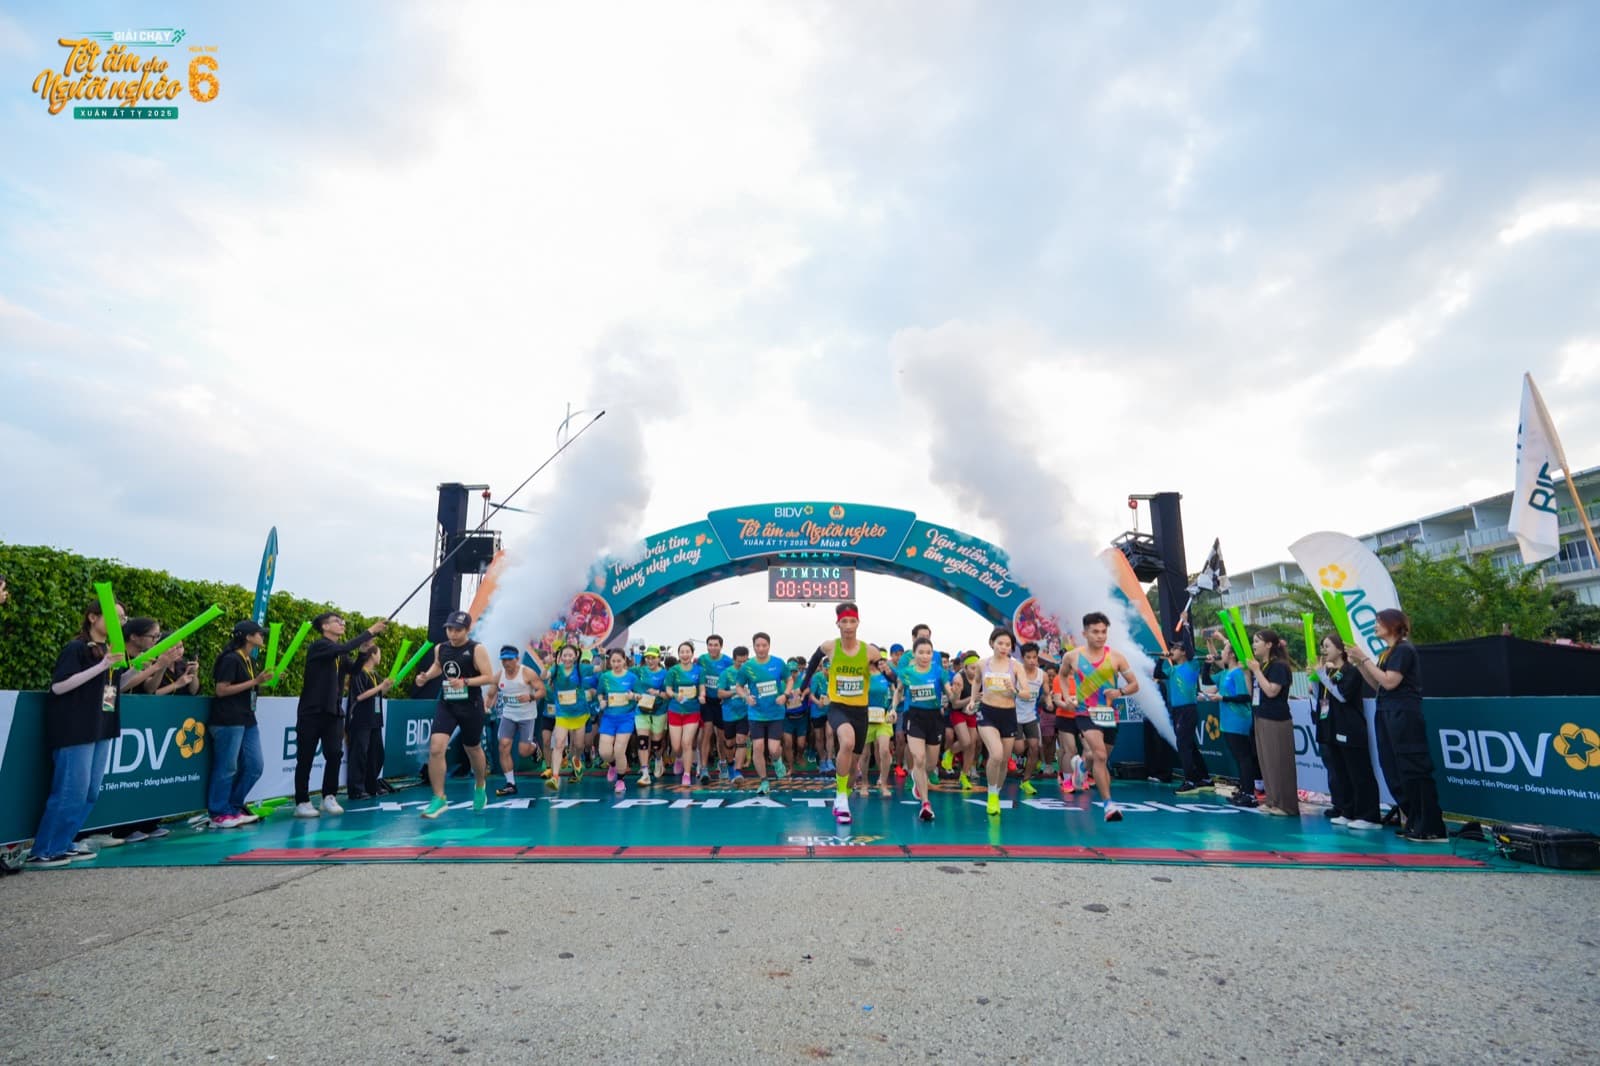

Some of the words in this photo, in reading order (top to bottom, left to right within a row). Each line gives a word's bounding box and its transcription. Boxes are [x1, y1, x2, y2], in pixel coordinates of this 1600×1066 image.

[774, 507, 803, 518] BIDV
[737, 518, 761, 539] Tết
[762, 521, 784, 538] ấm
[784, 528, 800, 538] cho
[800, 520, 844, 545] Người
[844, 522, 887, 545] nghèo
[668, 536, 690, 550] tim
[841, 539, 848, 547] 6
[612, 567, 645, 594] chung
[780, 567, 840, 579] TIMING
[776, 581, 849, 598] 00:54:03
[406, 718, 433, 746] BID
[1438, 728, 1552, 777] BIDV
[119, 780, 139, 789] Phong
[1496, 781, 1519, 791] Phong
[1524, 783, 1545, 795] Đồng
[1546, 785, 1566, 796] hành
[1567, 788, 1587, 799] Phát
